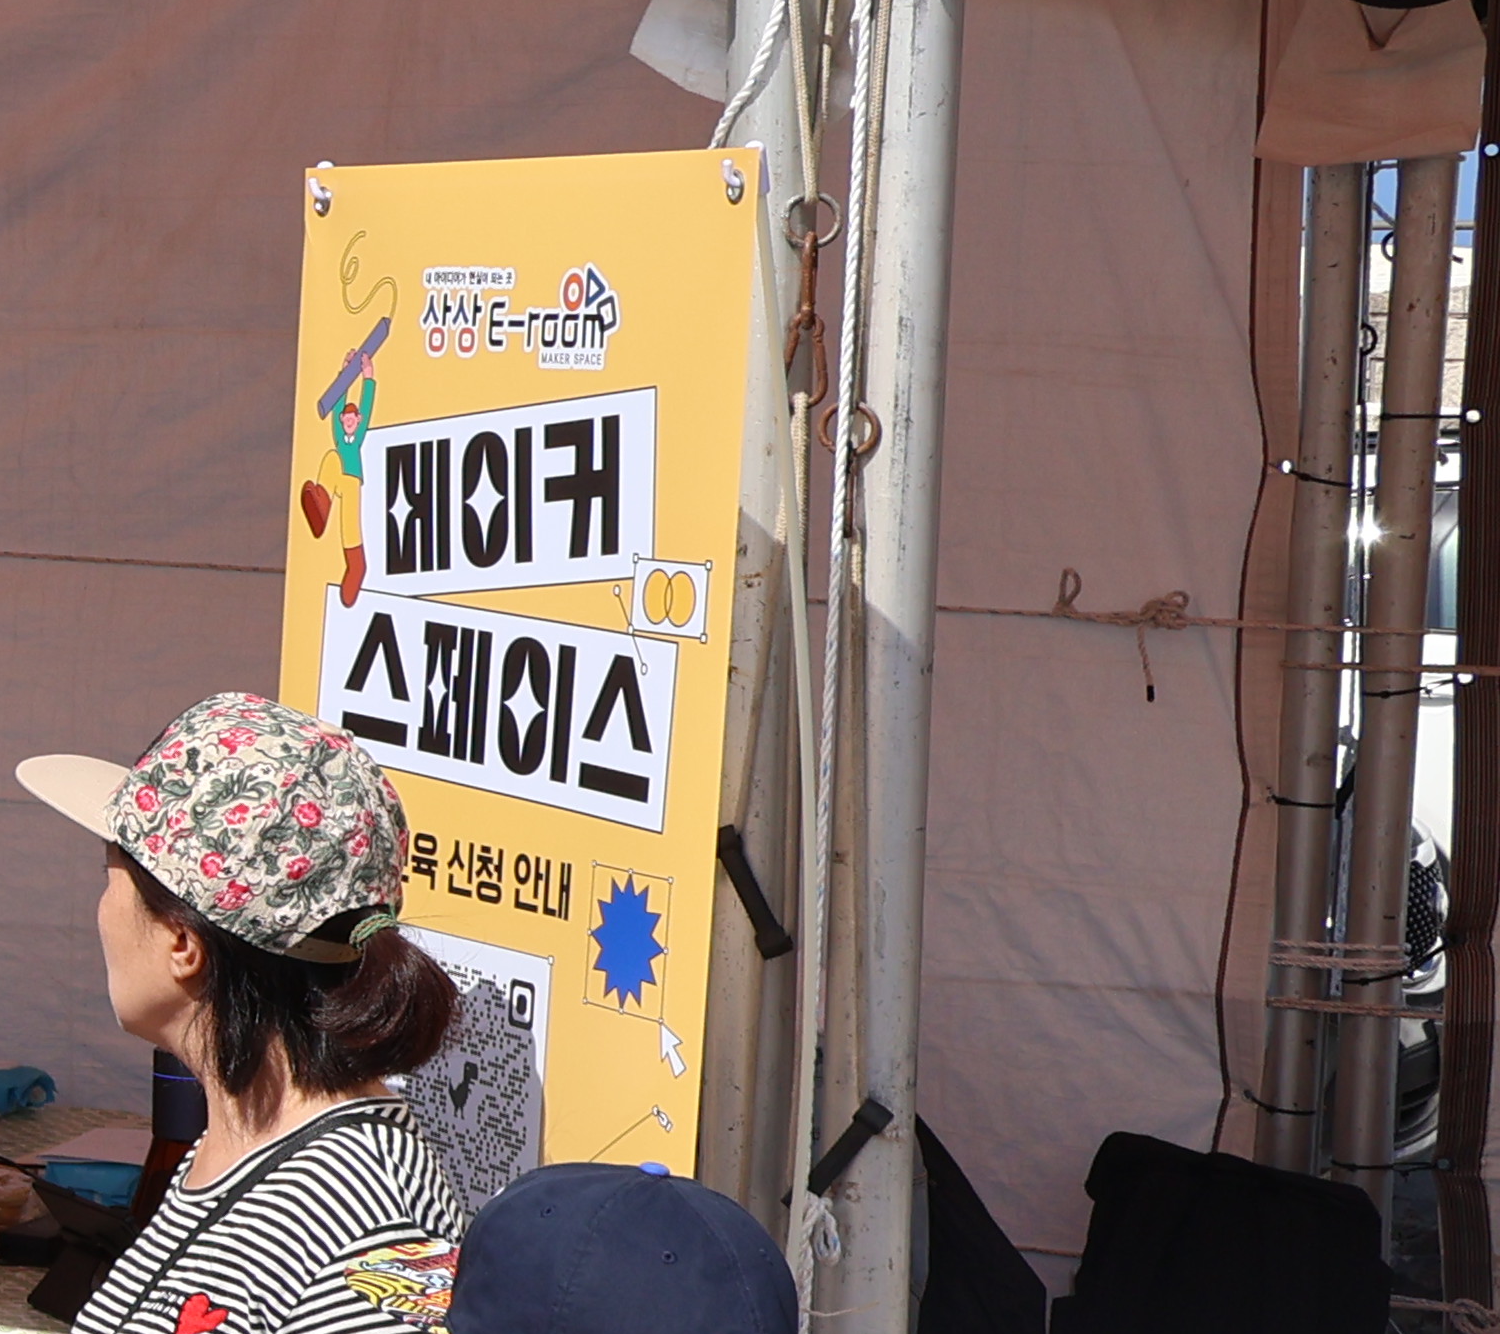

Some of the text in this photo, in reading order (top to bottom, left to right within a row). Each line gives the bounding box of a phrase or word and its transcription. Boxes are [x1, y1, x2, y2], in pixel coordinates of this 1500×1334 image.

[422, 292, 483, 353] 상상
[541, 352, 603, 366] MAKER SPACE
[384, 412, 620, 576] 메이커
[341, 611, 652, 801] 스페이스
[446, 839, 504, 906] 신청
[513, 852, 573, 922] 안내
